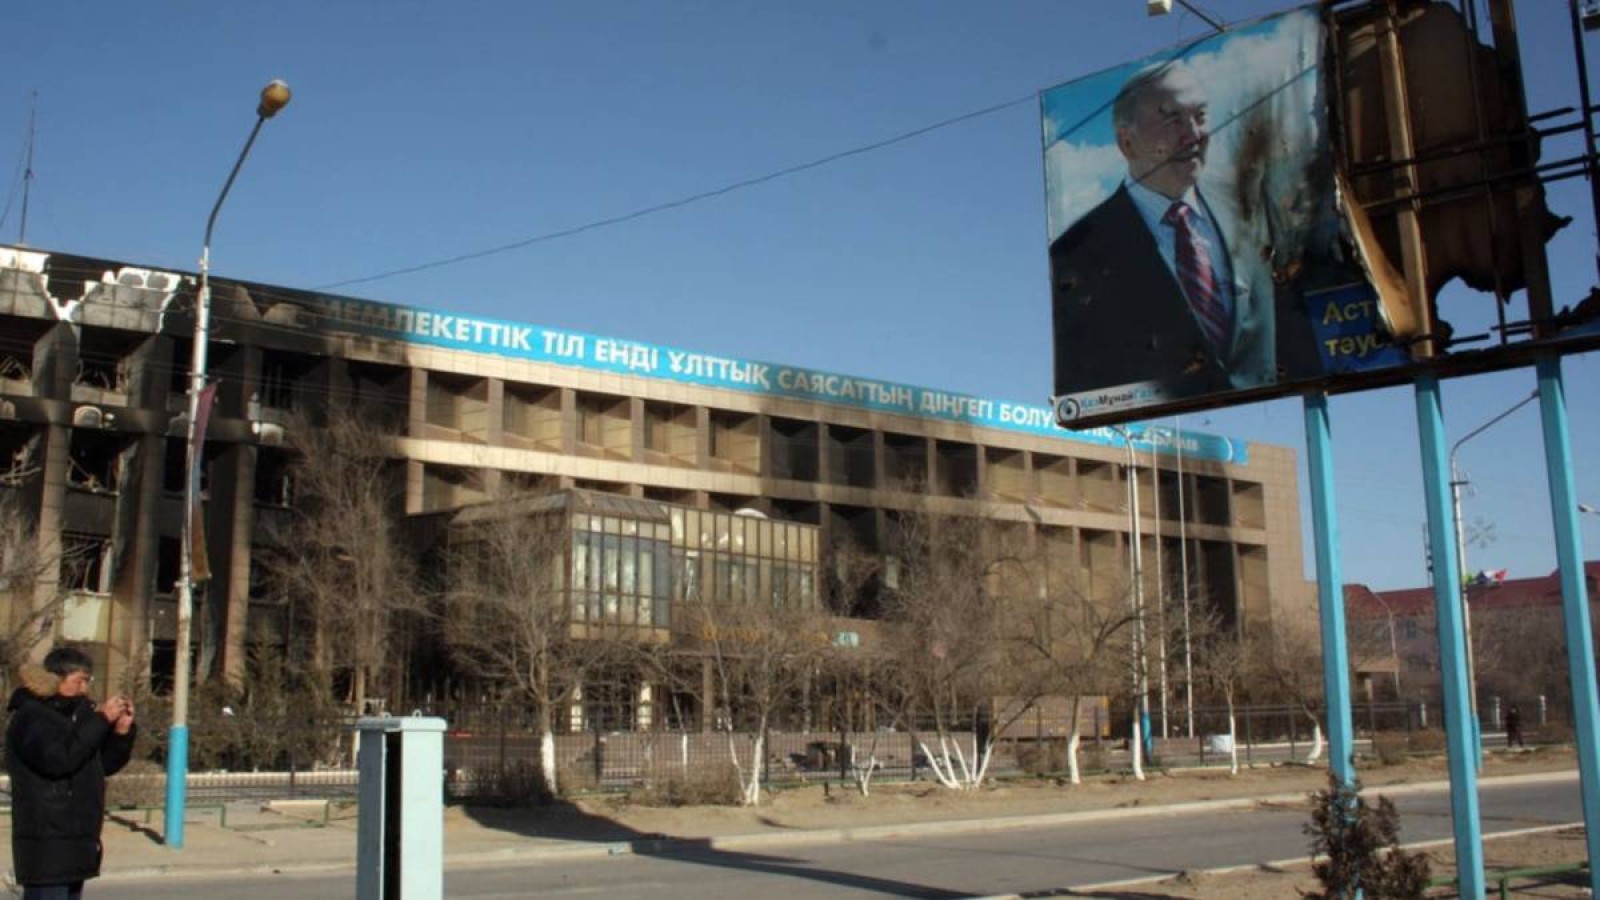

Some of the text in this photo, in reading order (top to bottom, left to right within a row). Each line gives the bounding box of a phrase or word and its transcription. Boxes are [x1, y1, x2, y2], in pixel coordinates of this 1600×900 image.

[1322, 299, 1375, 326] Аст
[321, 298, 532, 352] МЕМЛЕКЕТТІК
[541, 330, 585, 358] ТІЛ
[594, 338, 659, 373] ЕНДІ
[667, 350, 768, 392] ҰЛТТЫҚ
[777, 367, 914, 412] САЯСАТТЫҢ
[919, 391, 994, 421] ДІҢГЕГІ
